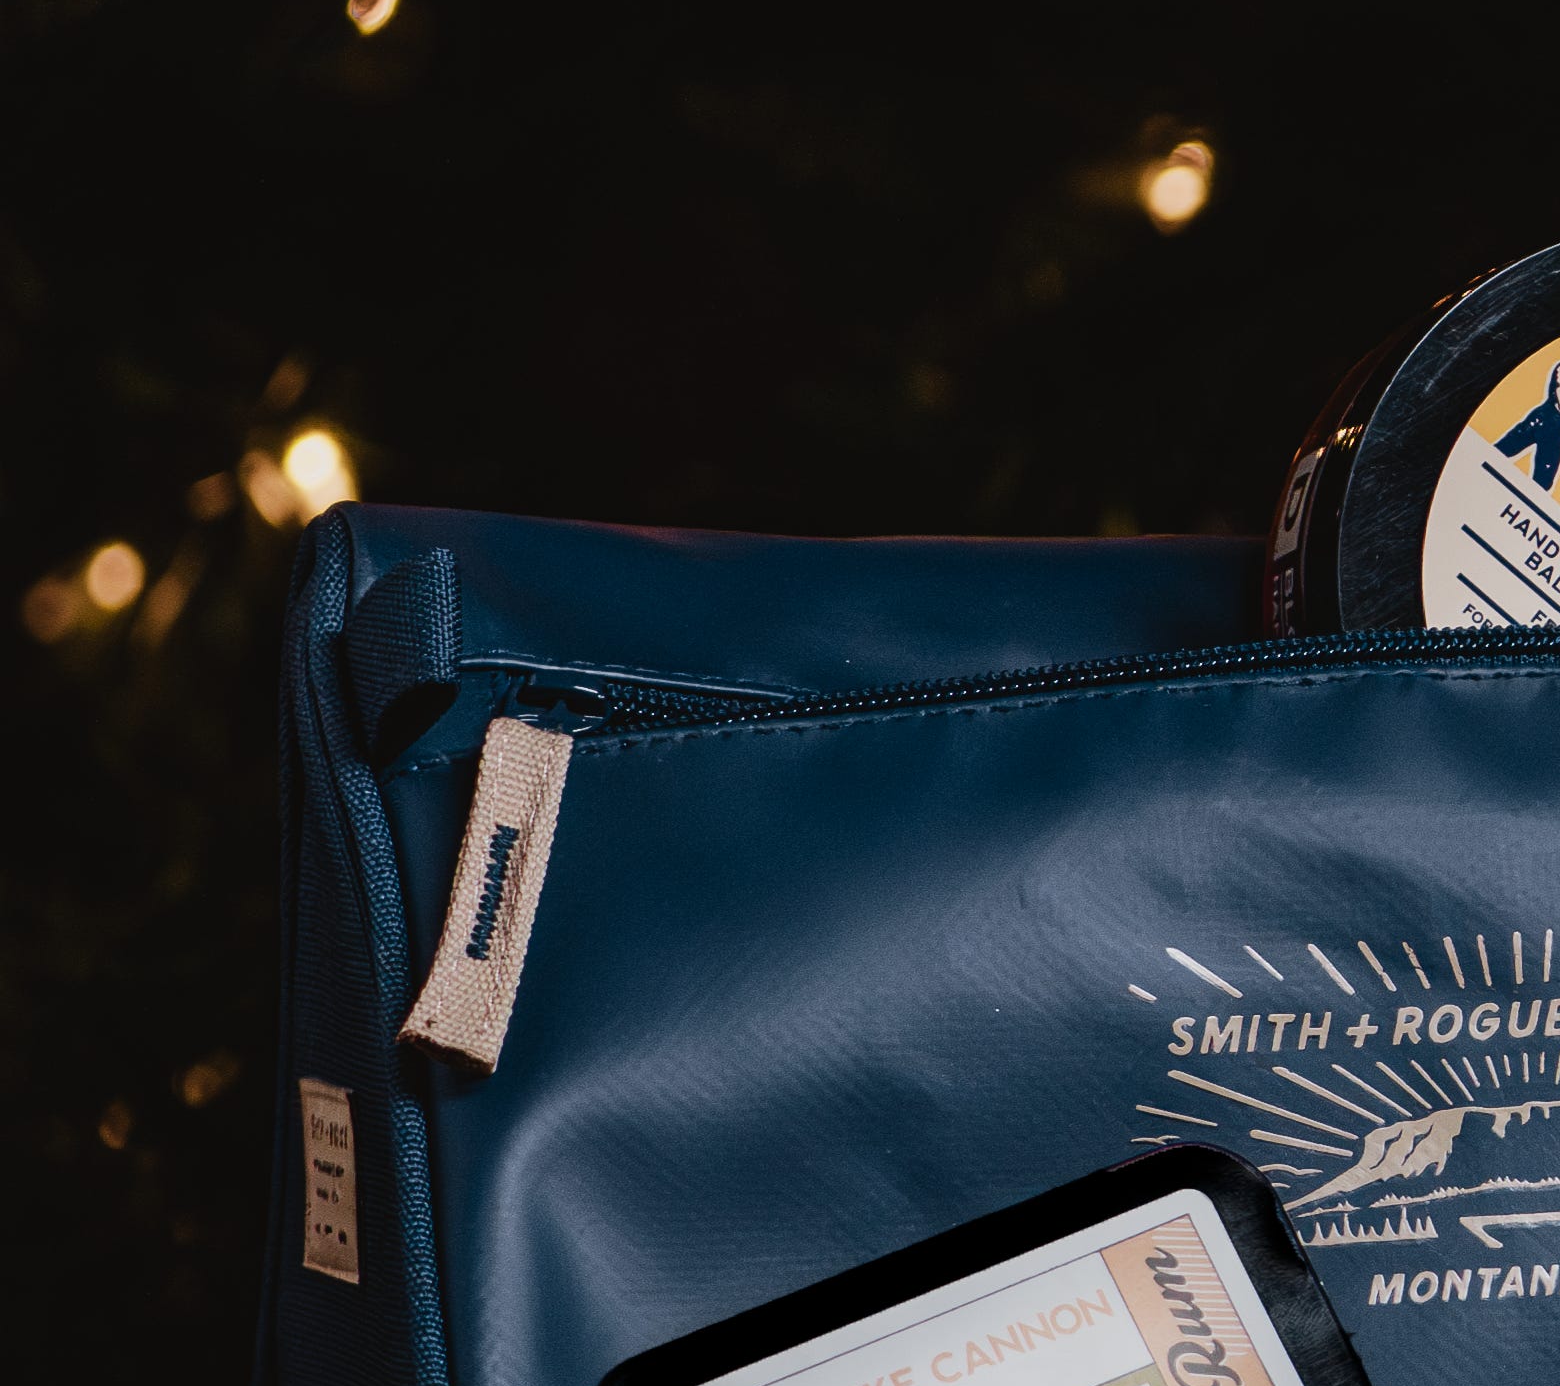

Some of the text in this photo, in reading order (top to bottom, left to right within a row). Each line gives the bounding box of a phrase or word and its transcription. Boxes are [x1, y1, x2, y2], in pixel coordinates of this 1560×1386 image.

[1500, 503, 1560, 559] HAND
[1167, 1011, 1333, 1056] SMITH
[930, 1288, 1115, 1383] CANNON
